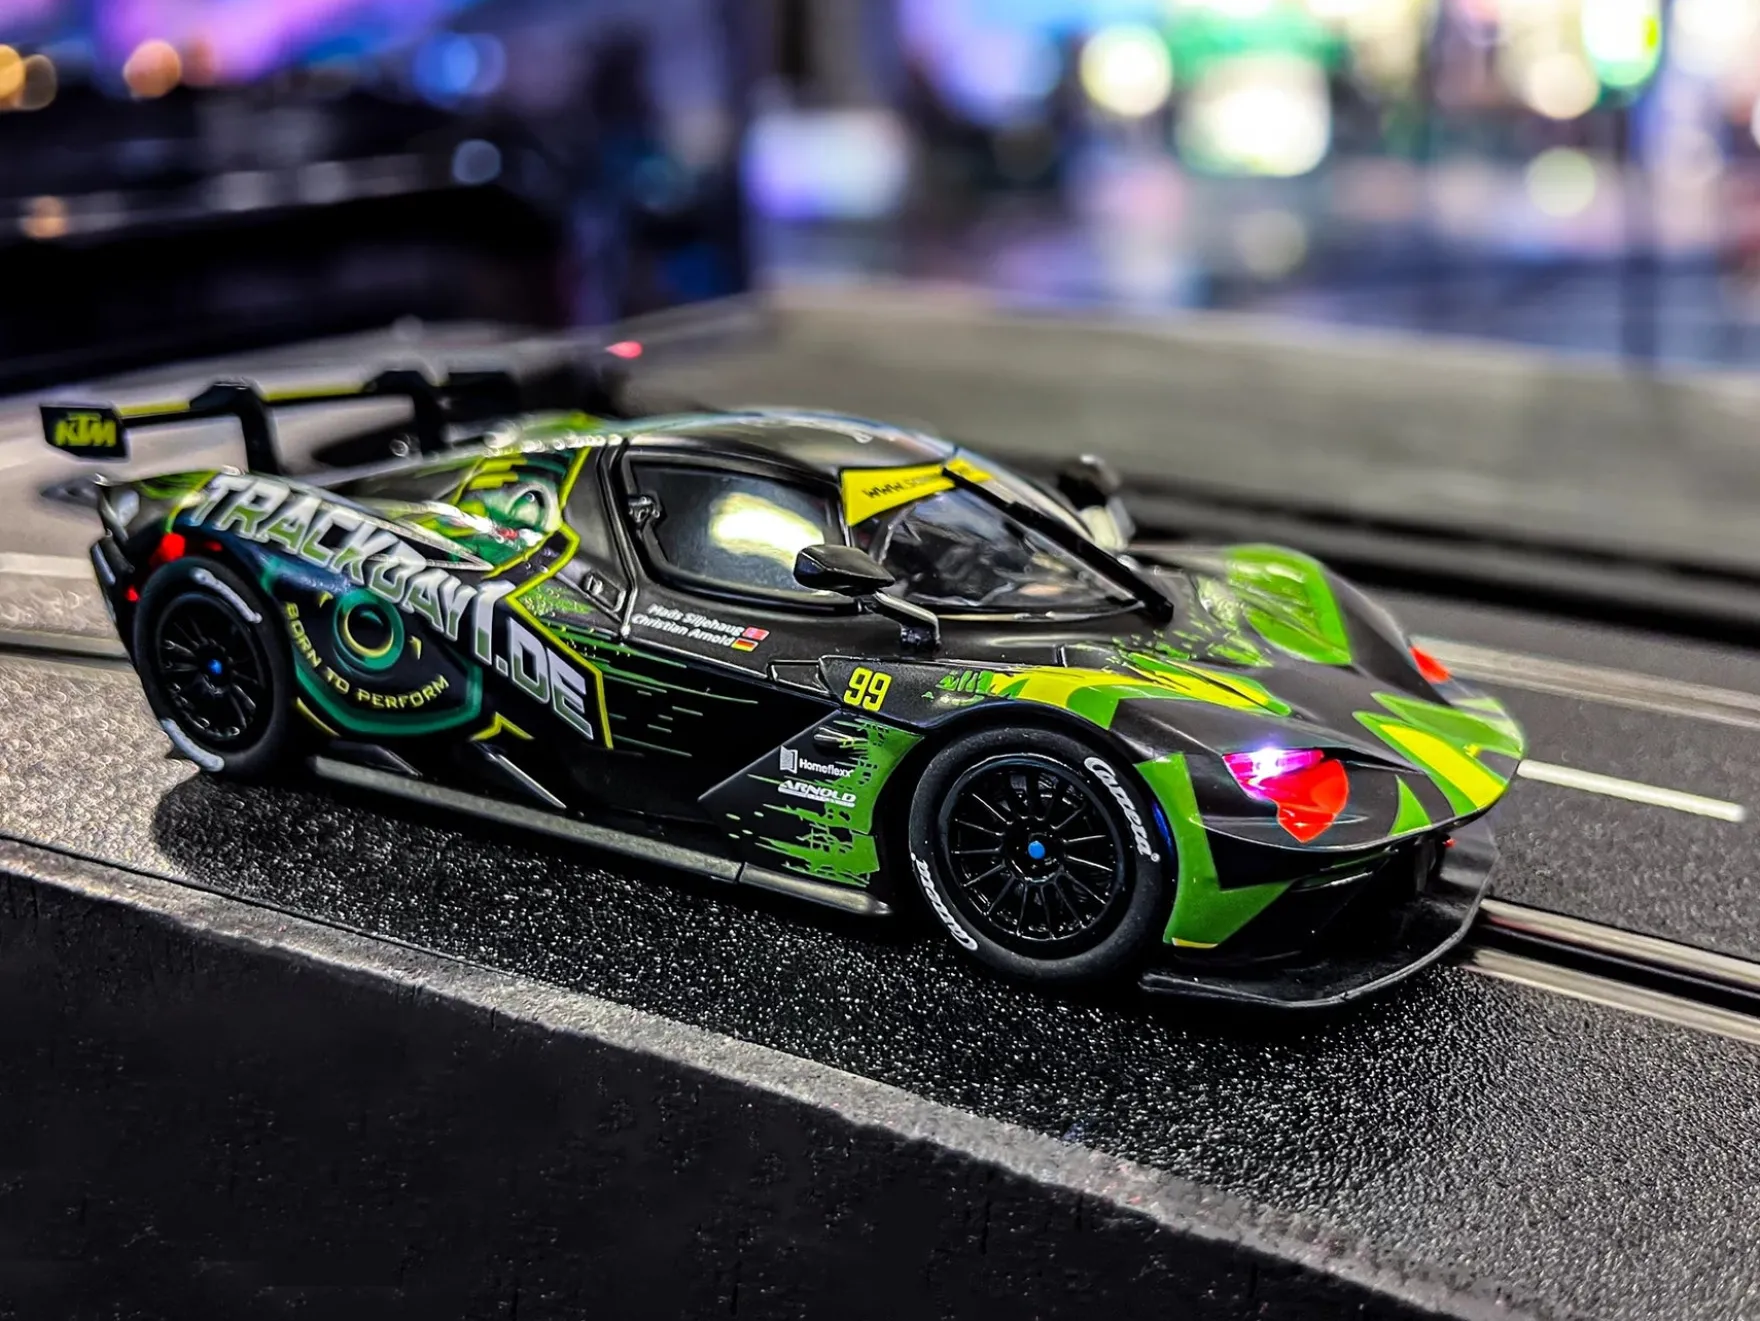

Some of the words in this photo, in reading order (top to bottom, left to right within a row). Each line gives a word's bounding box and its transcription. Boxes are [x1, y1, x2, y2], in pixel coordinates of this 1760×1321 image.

[55, 412, 117, 447] KTM
[631, 613, 689, 636] Christian
[687, 628, 735, 646] Arnold
[285, 602, 323, 669] BORN
[324, 667, 350, 695] TO
[356, 673, 450, 709] PERFORM
[843, 666, 893, 712] 99
[779, 780, 857, 802] ARNOLD
